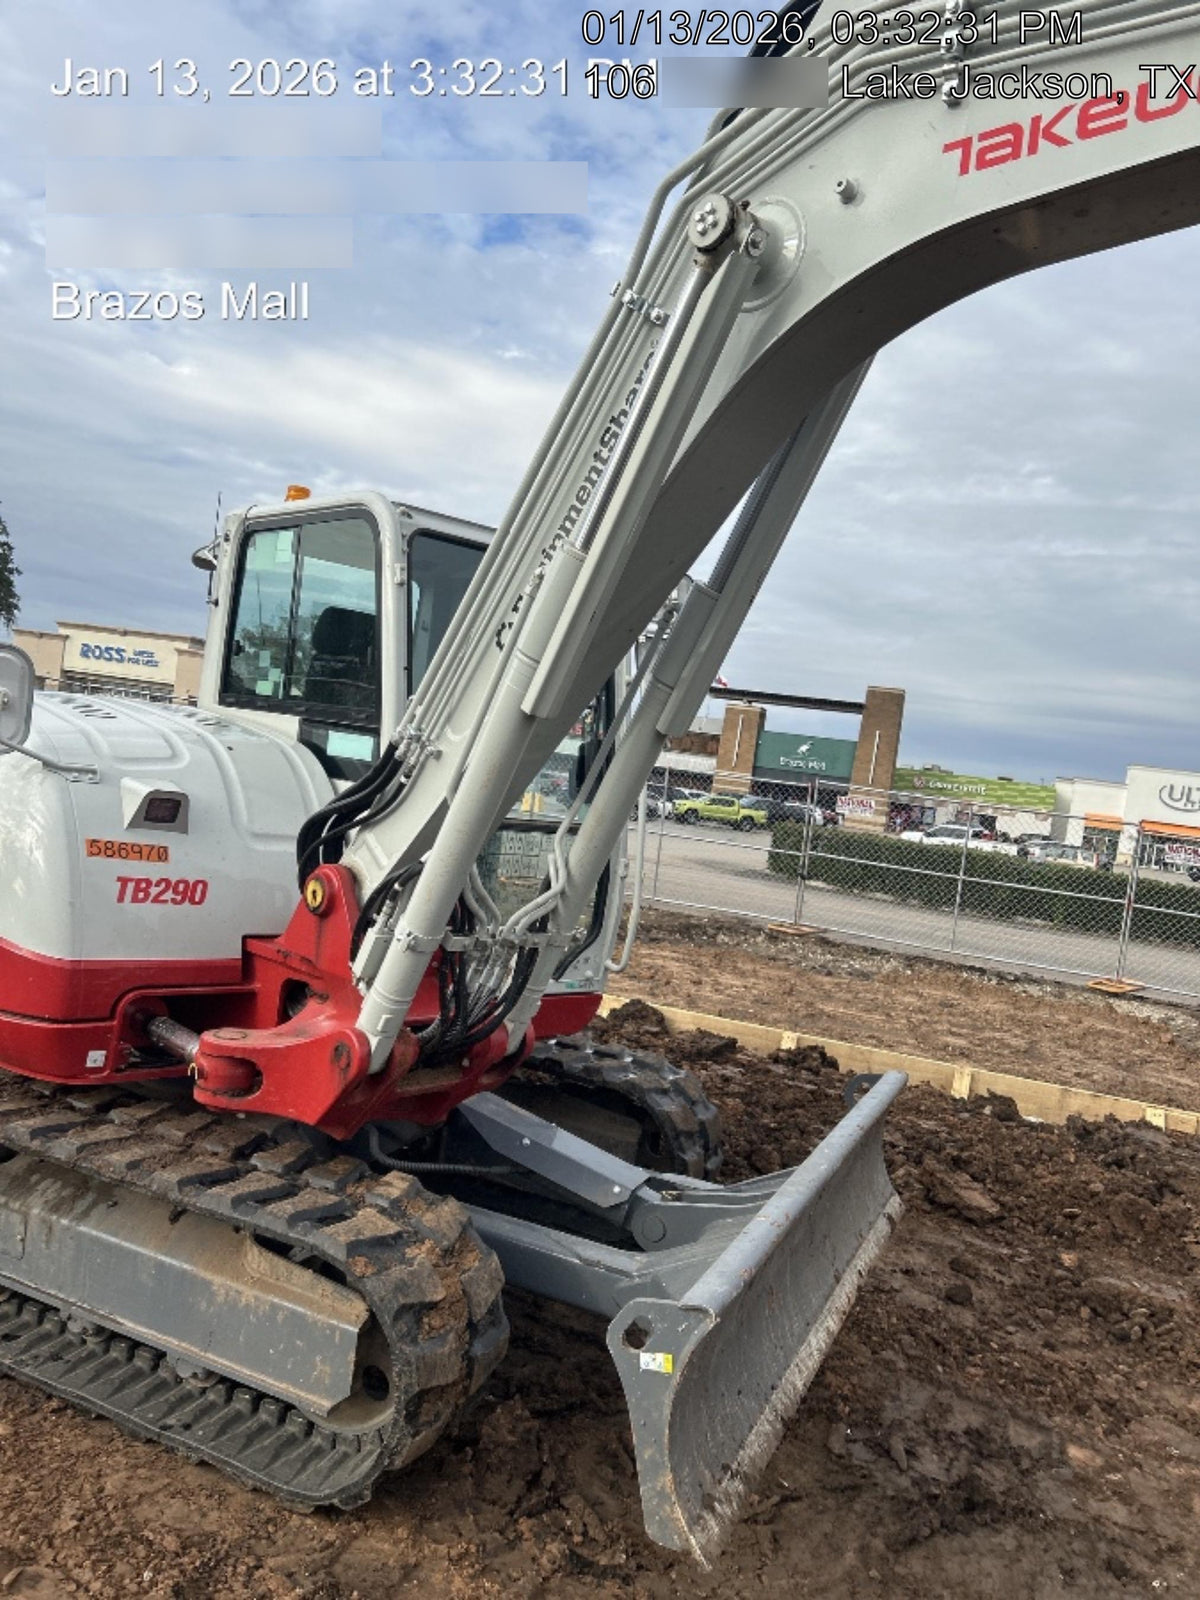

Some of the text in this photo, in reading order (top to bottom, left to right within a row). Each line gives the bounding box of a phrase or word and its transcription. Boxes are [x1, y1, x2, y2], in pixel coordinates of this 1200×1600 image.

[80, 643, 127, 664] ROSS
[89, 839, 170, 863] 586970
[116, 876, 208, 906] TB290
